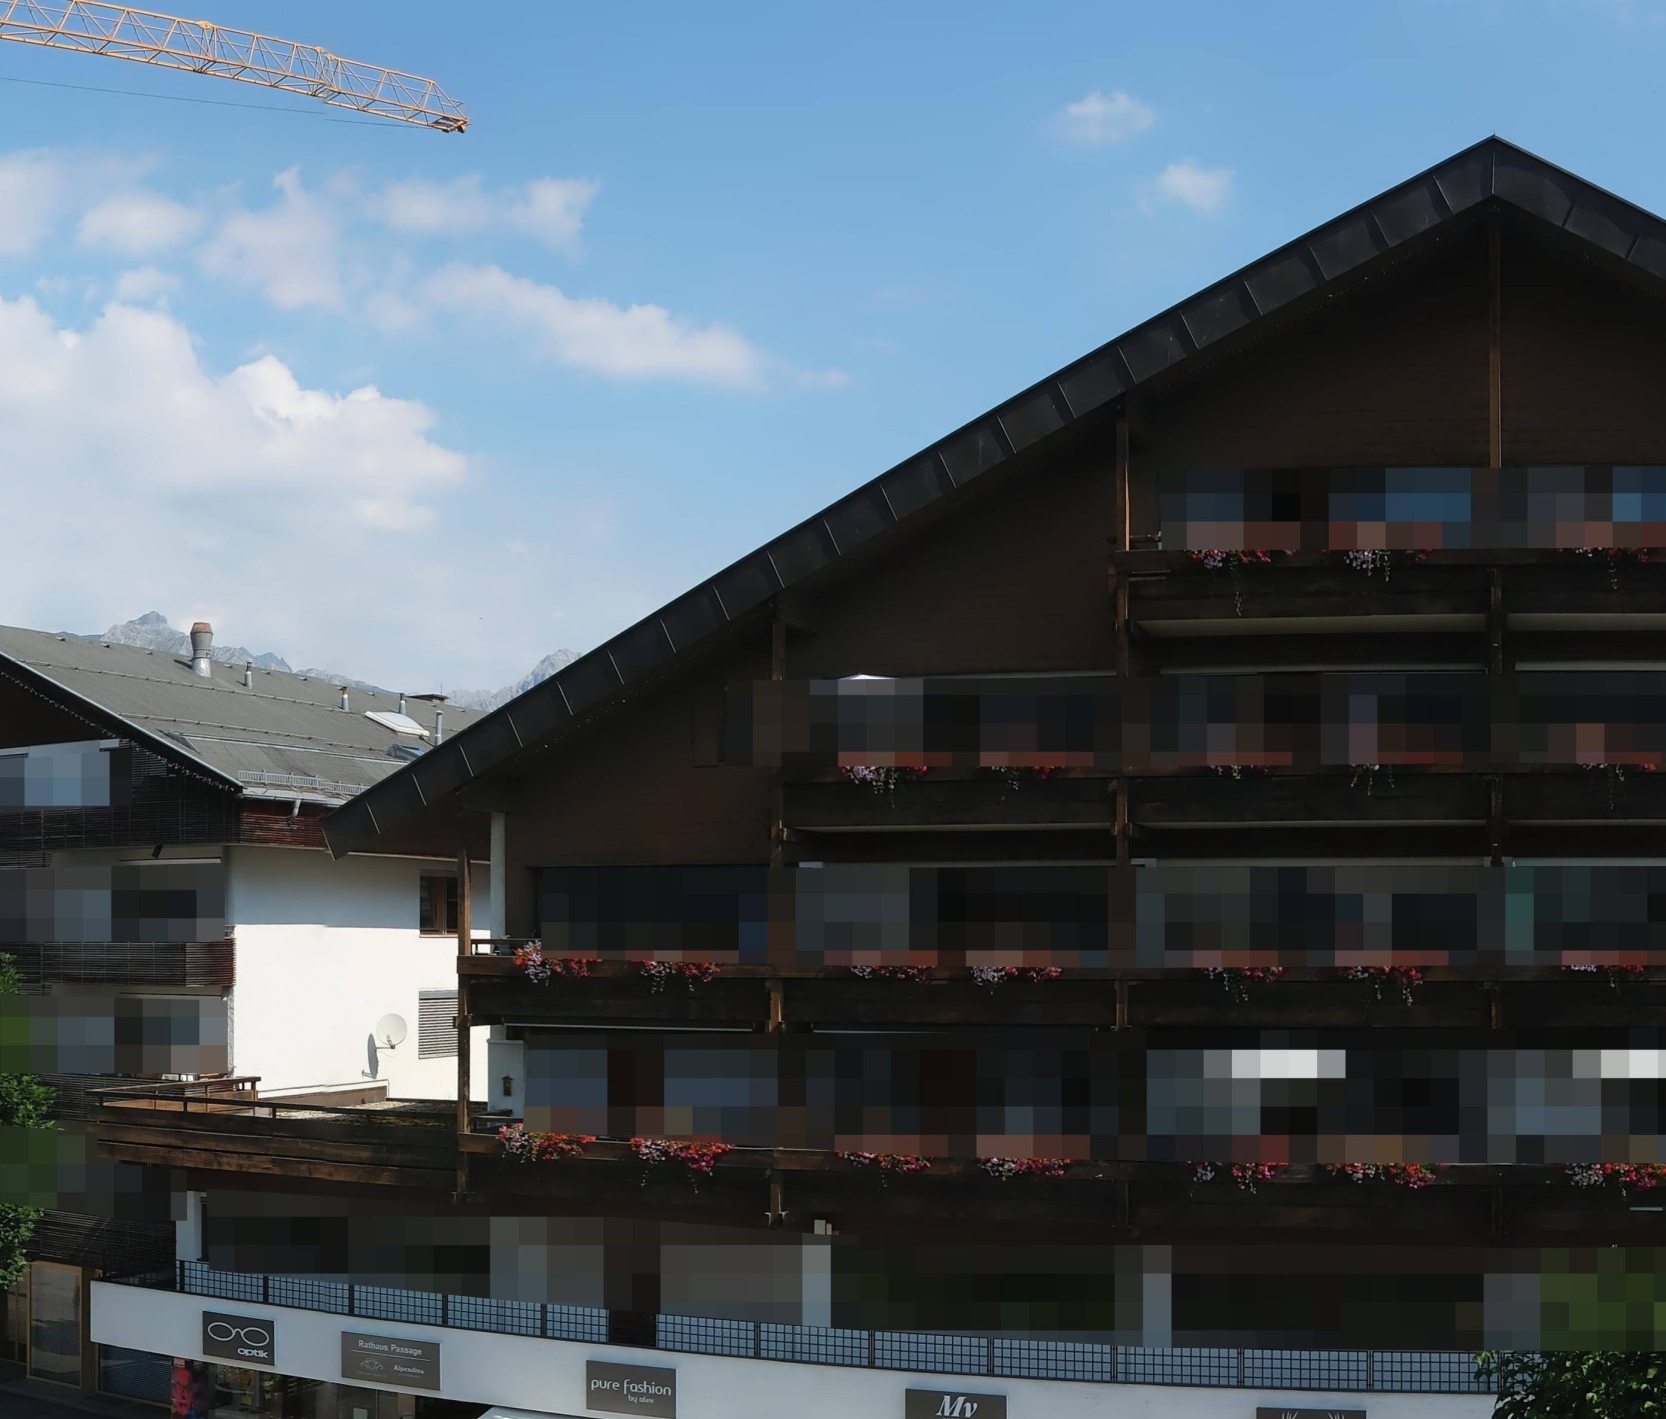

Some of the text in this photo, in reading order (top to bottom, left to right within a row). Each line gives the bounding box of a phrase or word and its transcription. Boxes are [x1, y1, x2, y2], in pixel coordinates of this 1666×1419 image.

[237, 1347, 270, 1359] optik
[358, 1340, 422, 1356] Rathaus Passage
[591, 1378, 672, 1396] pure fashion
[628, 1394, 654, 1404] by alex
